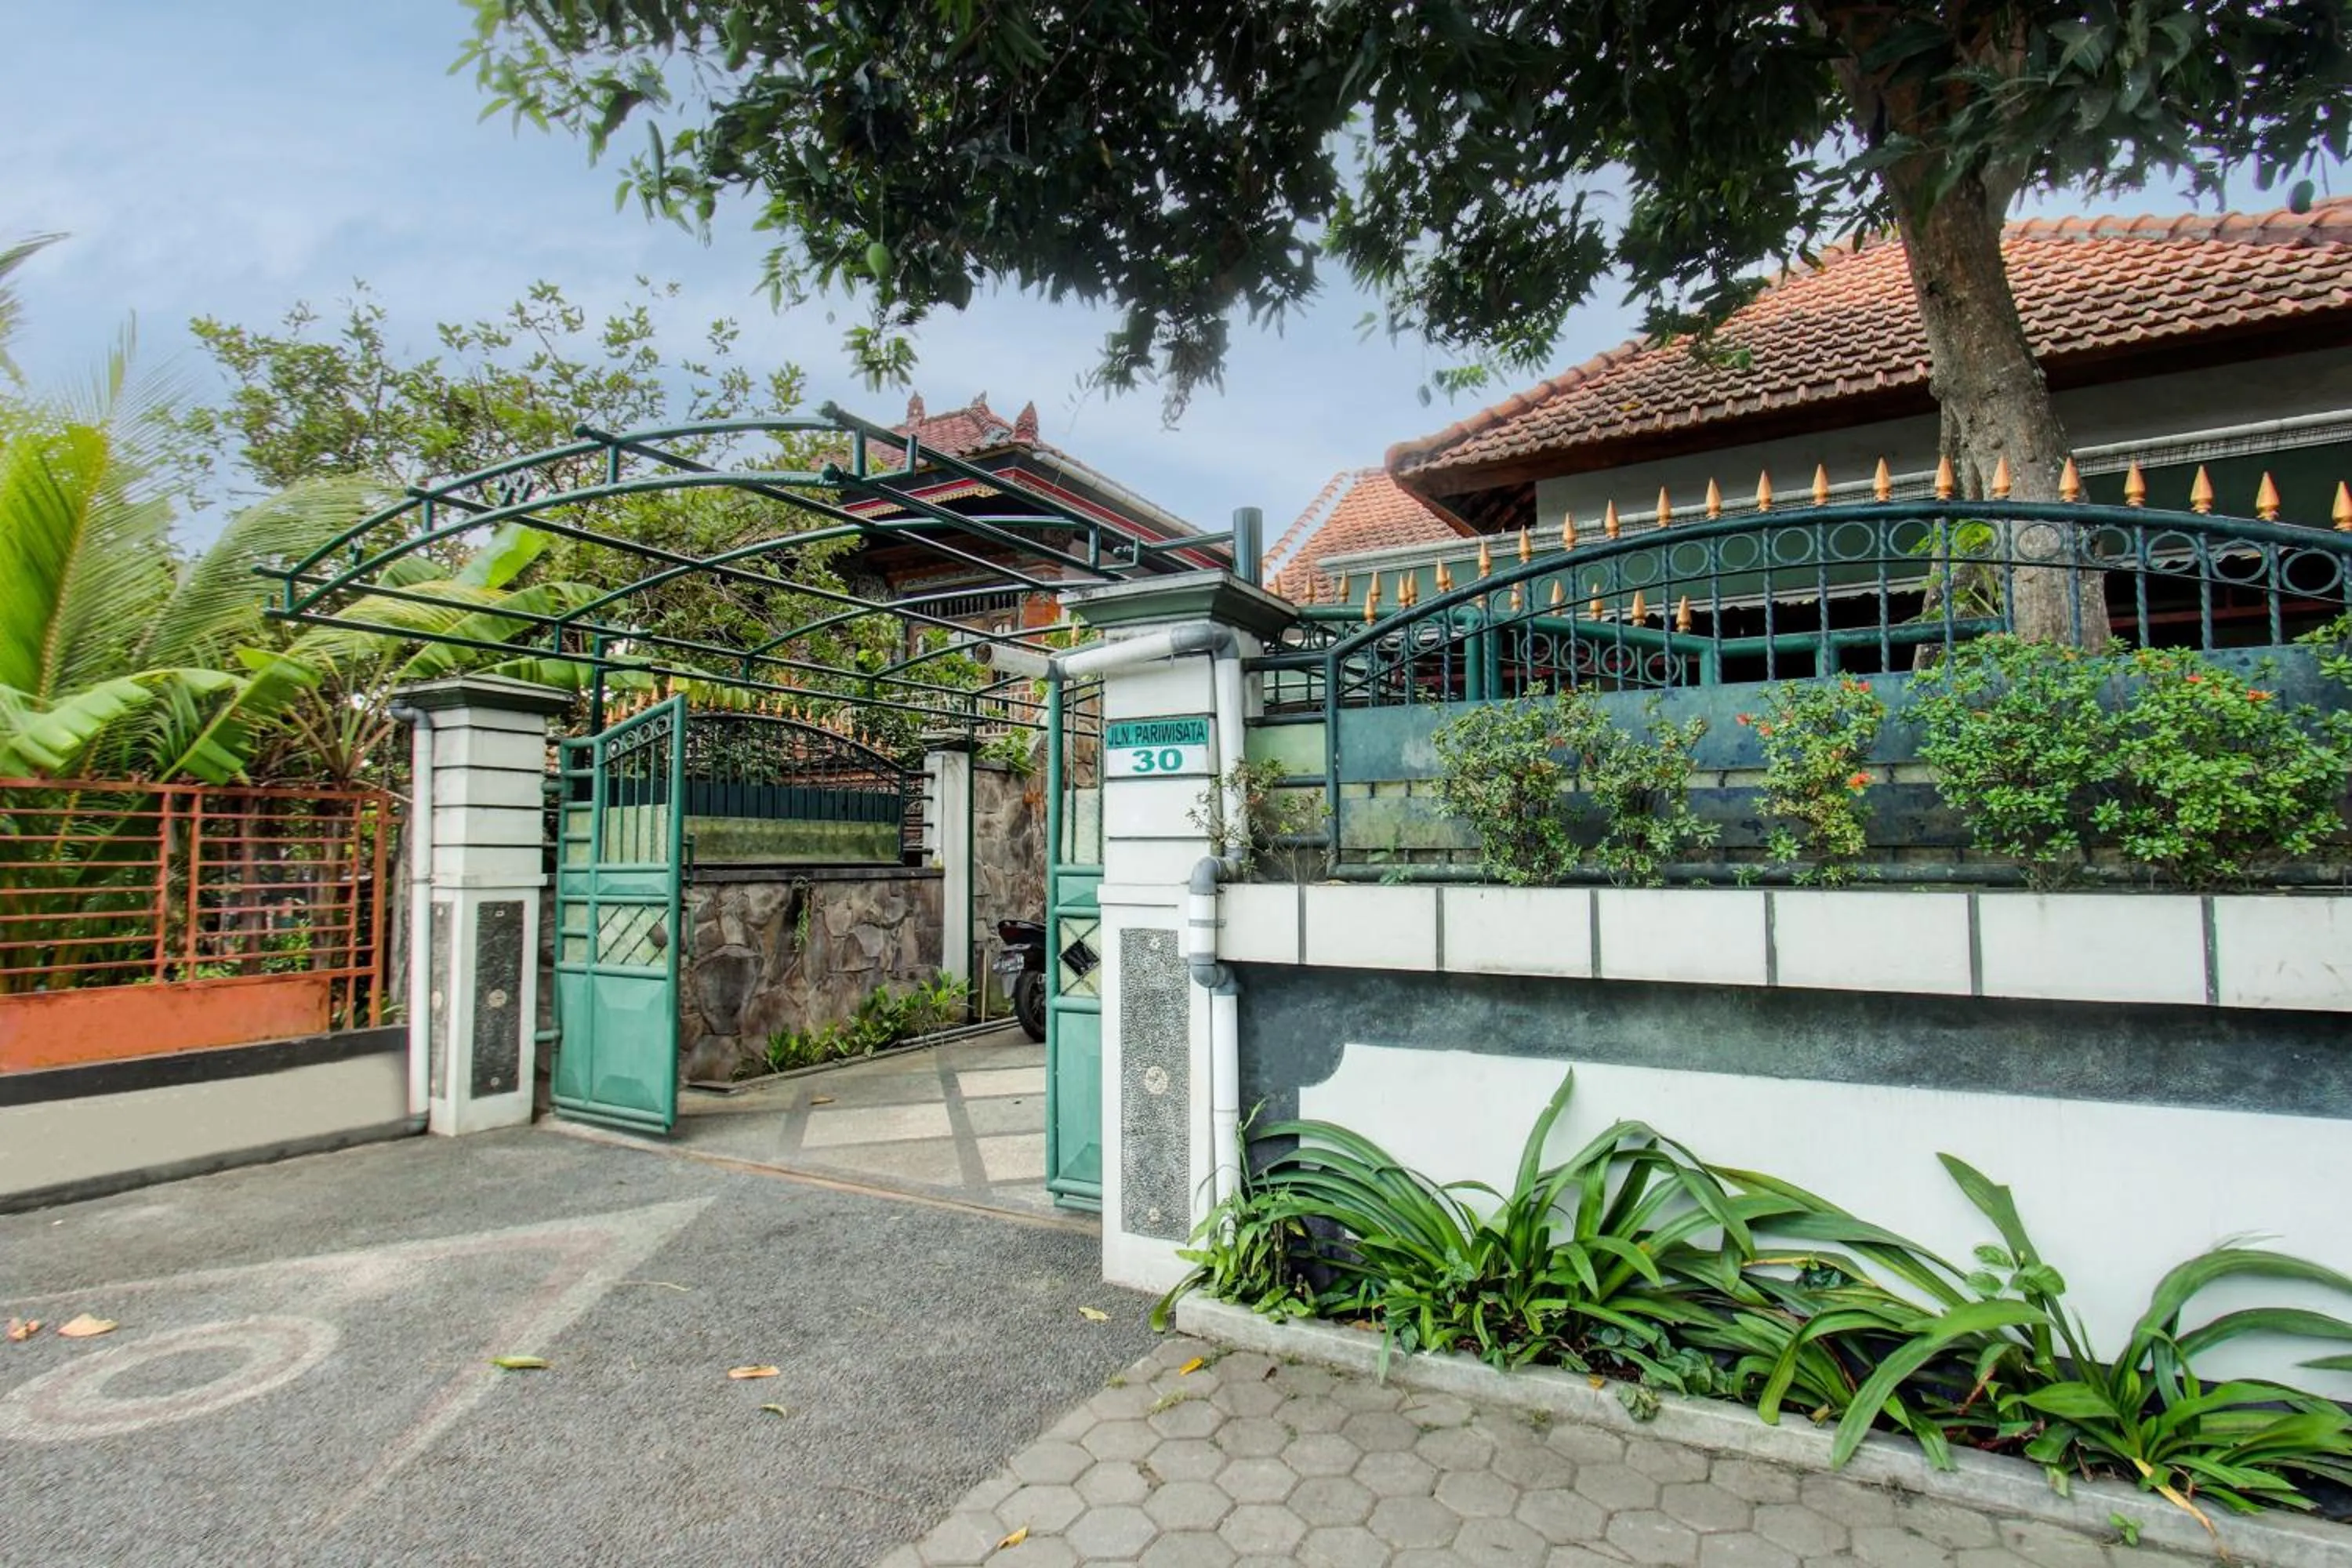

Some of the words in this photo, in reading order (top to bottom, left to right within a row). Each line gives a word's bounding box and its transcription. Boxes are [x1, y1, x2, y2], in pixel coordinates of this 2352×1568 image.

[1108, 727, 1132, 745] JLN.
[1135, 721, 1204, 743] PARIWISATA
[1132, 748, 1183, 772] 30
